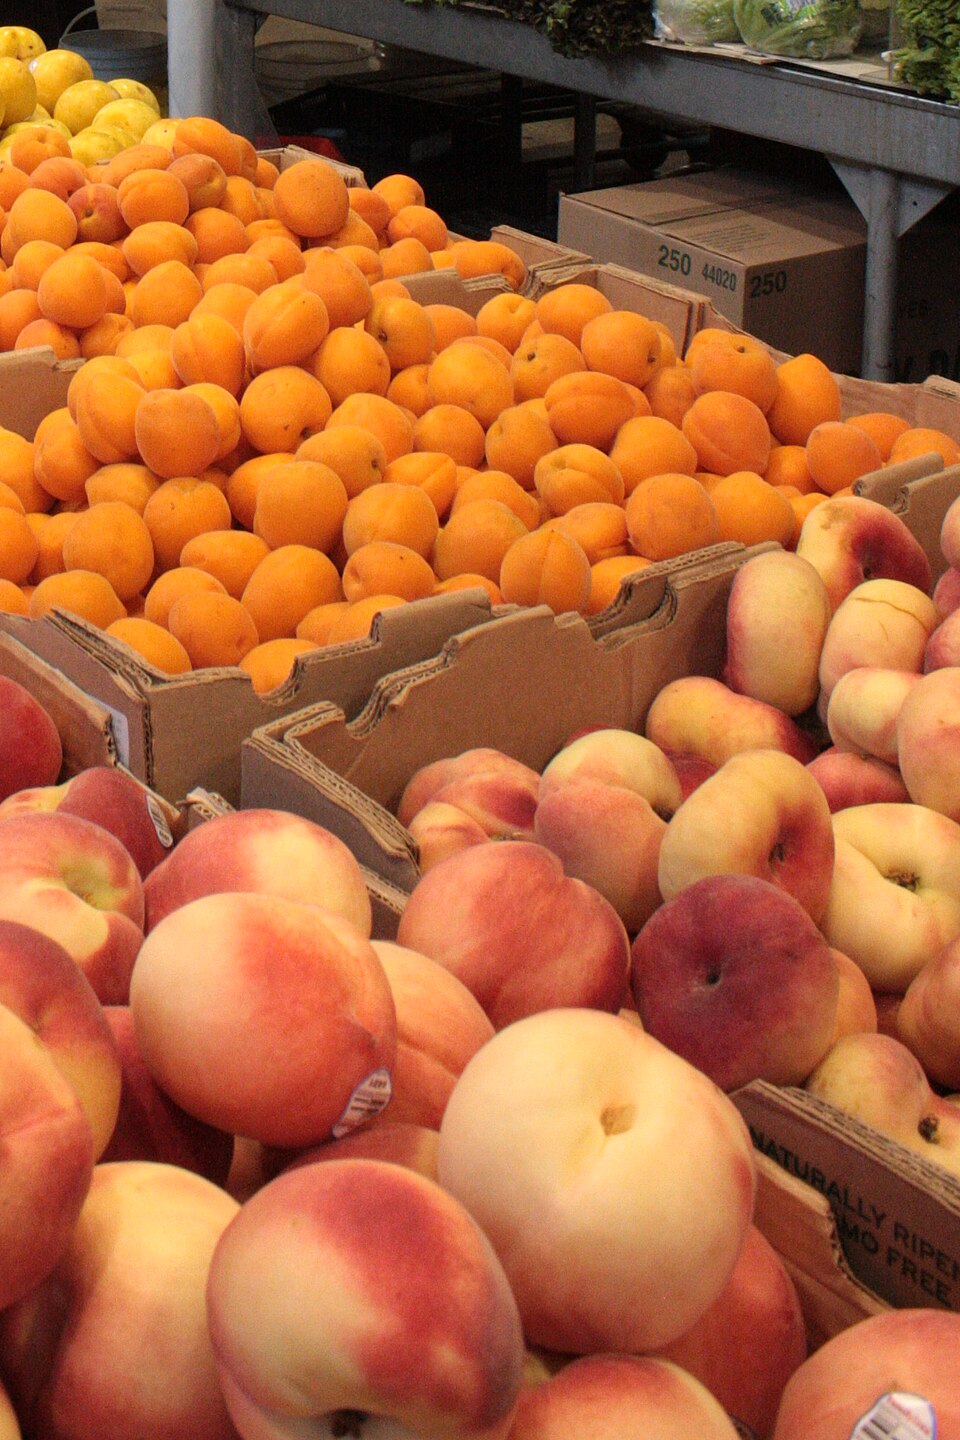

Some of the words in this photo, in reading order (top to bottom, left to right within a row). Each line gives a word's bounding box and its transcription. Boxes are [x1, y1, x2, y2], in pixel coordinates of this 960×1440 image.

[658, 244, 692, 276] 250
[701, 263, 737, 293] 44020
[750, 270, 788, 299] 250
[749, 1123, 888, 1229] NATURALLY
[887, 1246, 953, 1309] FREE
